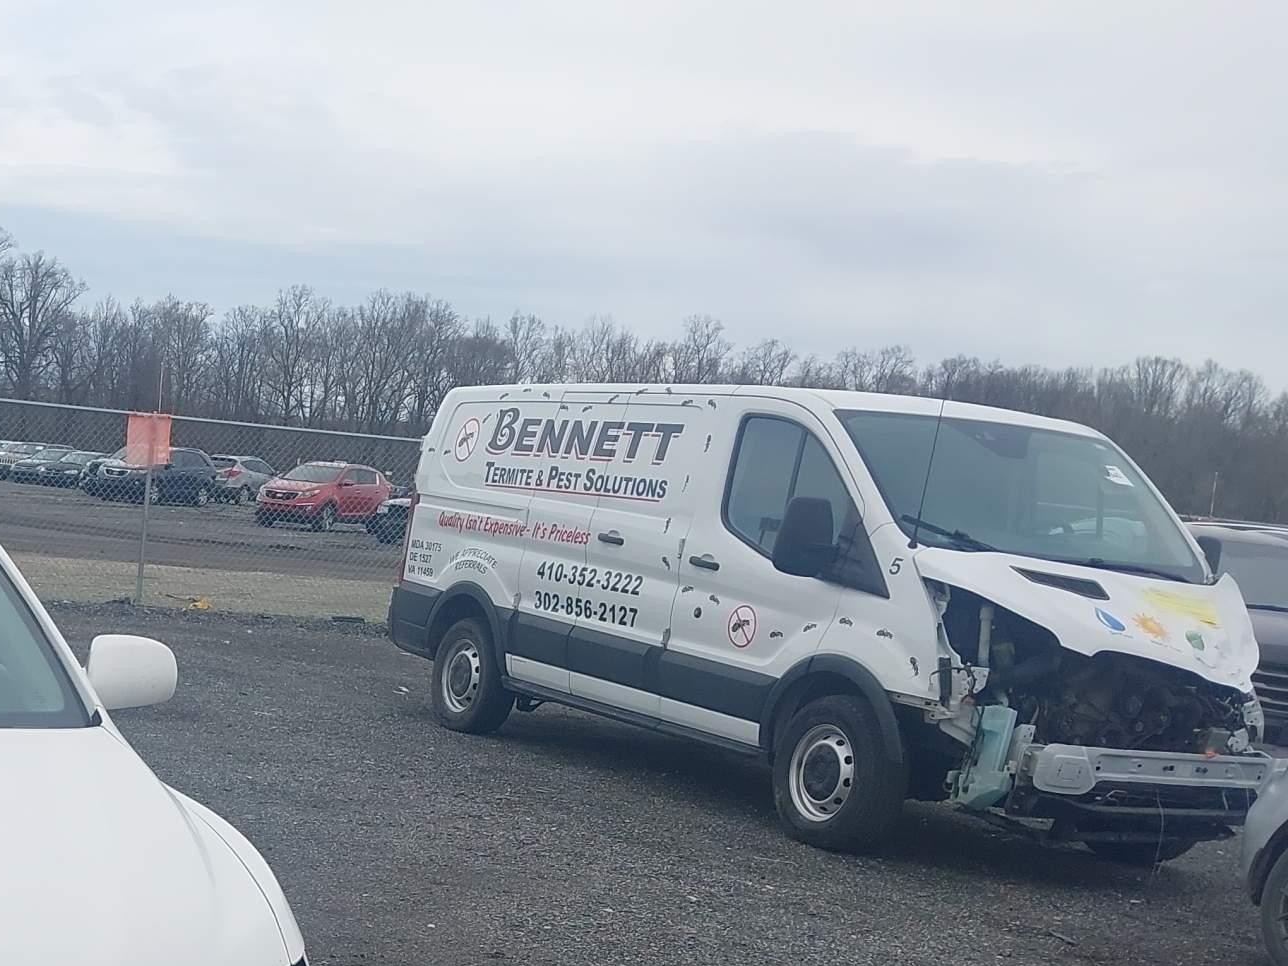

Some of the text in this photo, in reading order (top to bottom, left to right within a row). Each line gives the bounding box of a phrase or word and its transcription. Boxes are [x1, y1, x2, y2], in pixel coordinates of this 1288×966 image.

[485, 408, 684, 465] BENNETT
[485, 462, 668, 498] TERMITE & PEST SOLUTIONS
[439, 511, 465, 533] Quality
[465, 514, 482, 530] Isn't
[532, 522, 546, 539] It's
[548, 524, 591, 545] Priceless
[408, 564, 416, 575] VA
[409, 552, 418, 561] DE
[889, 557, 904, 576] 5
[537, 561, 644, 596] 410-352-3222
[534, 591, 638, 627] 302-856-2127
